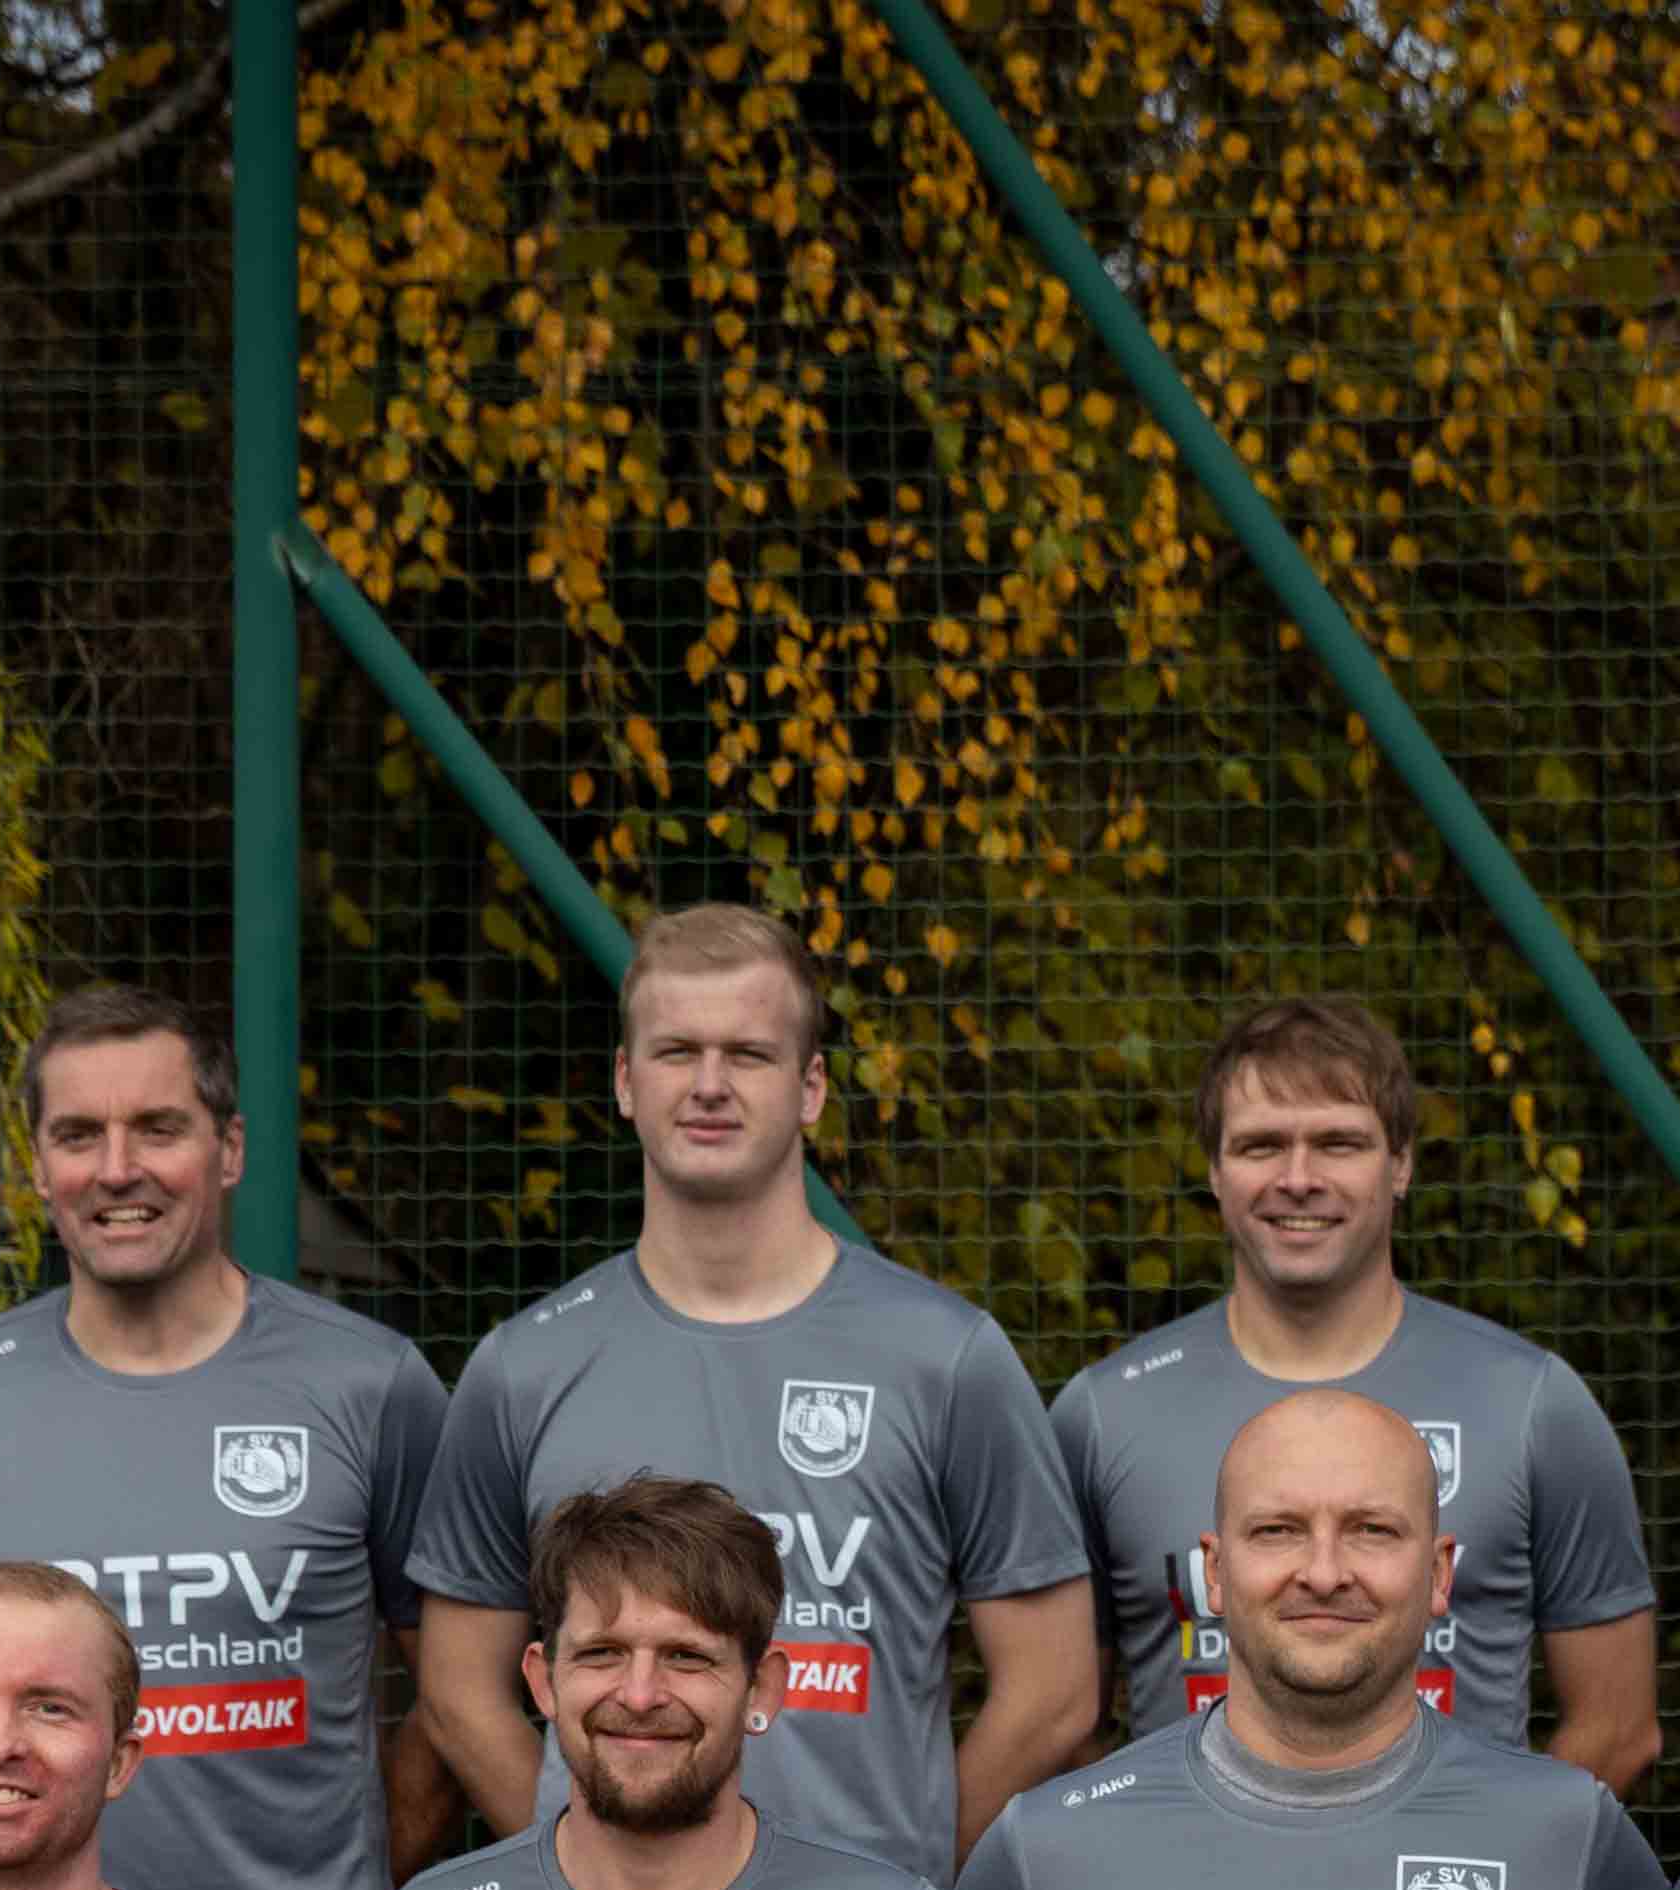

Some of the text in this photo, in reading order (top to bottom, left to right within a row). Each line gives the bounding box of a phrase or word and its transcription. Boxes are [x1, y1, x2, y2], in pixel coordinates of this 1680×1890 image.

[134, 1628, 305, 1672] schland
[132, 1696, 299, 1737] OVOLTAIK
[1090, 1773, 1136, 1799] JAKO
[1438, 1867, 1466, 1882] SV
